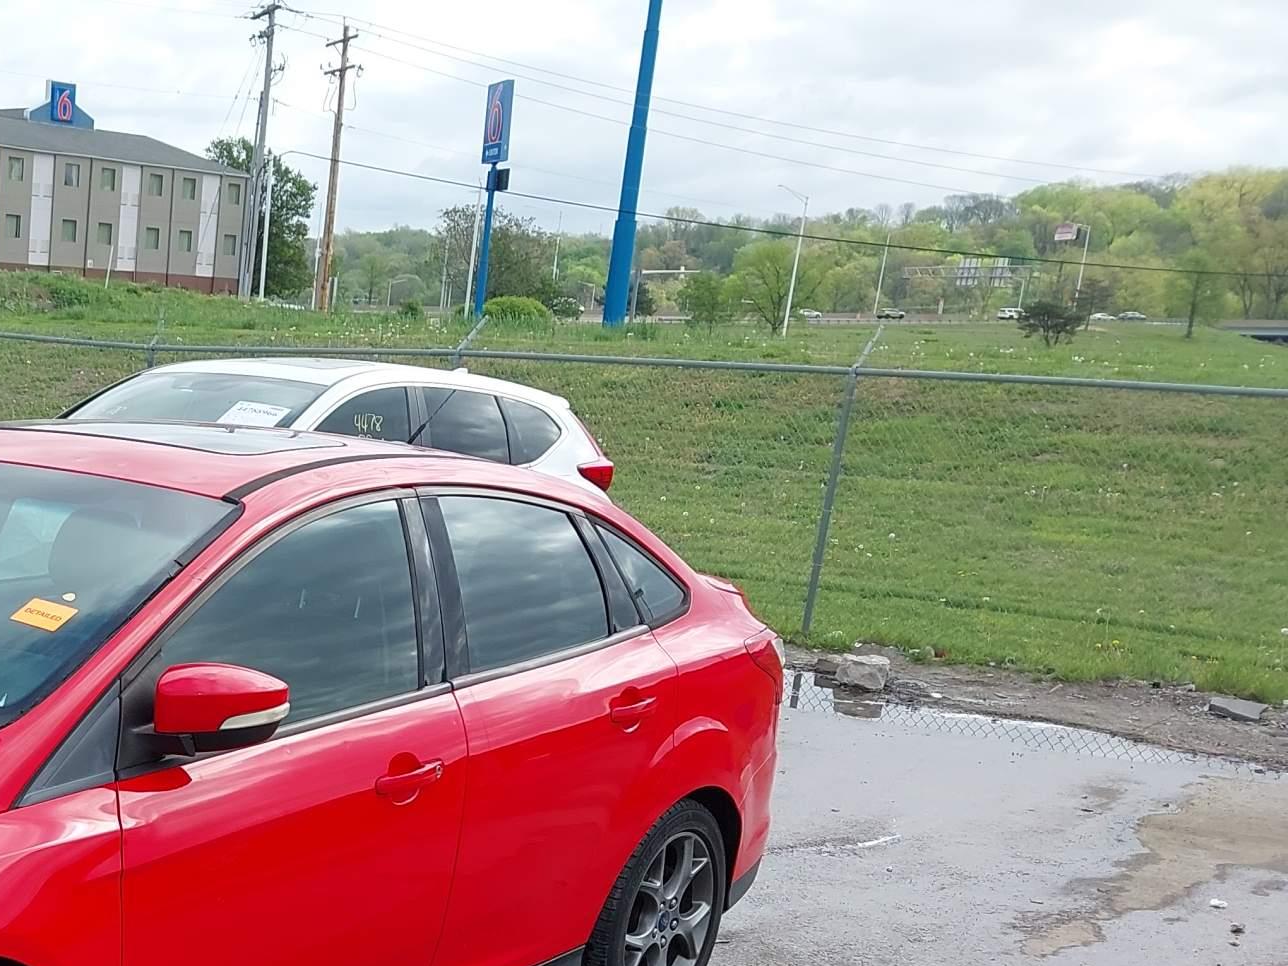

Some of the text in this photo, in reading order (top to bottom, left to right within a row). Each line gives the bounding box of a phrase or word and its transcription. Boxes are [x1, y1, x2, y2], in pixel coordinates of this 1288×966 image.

[58, 90, 72, 121] 6
[488, 83, 503, 144] 6
[354, 413, 383, 432] 4478
[24, 607, 63, 622] DETAILED
